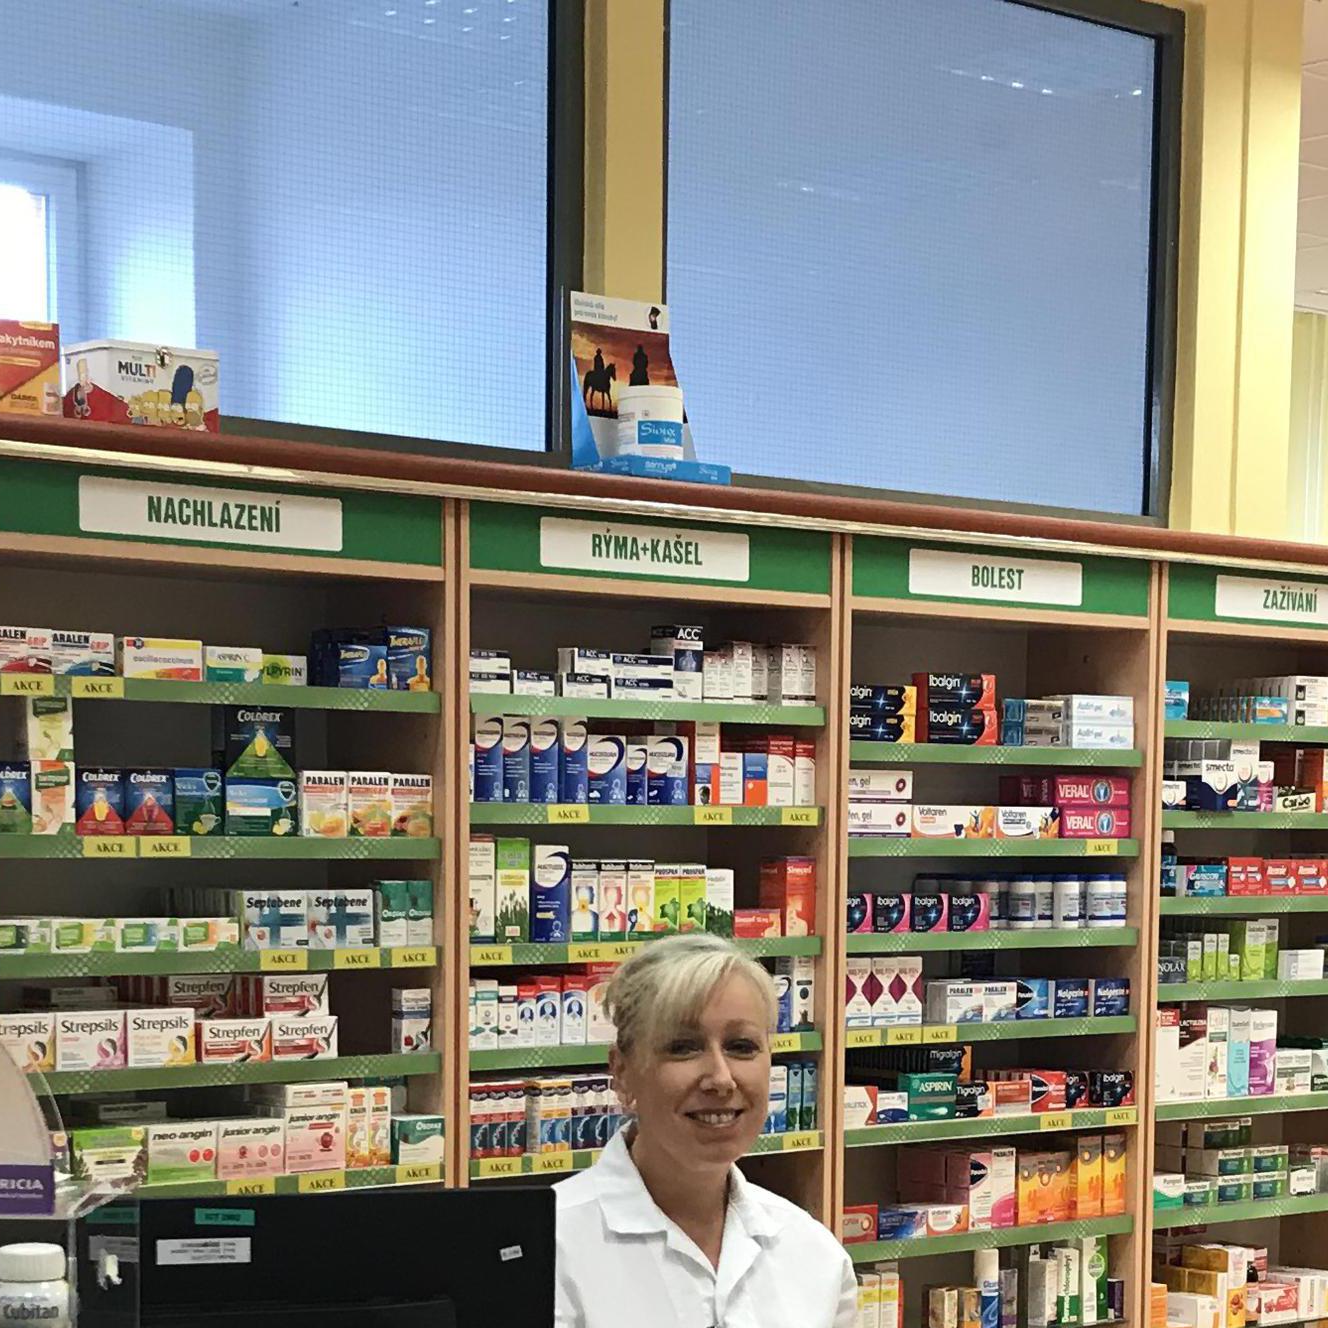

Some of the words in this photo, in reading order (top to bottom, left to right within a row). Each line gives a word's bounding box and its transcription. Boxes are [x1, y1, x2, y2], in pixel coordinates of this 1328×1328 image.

[118, 361, 155, 377] MULTI
[148, 496, 281, 533] NACHLAZENÍ
[592, 528, 703, 565] RÝMA+KAŠEL
[972, 565, 1024, 590] BOLEST
[1263, 585, 1317, 613] ZAŽÍVÁNÍ
[678, 628, 700, 640] ACC
[13, 680, 43, 692] AKCE
[82, 683, 113, 694] AKCE
[237, 708, 282, 723] COLDREX
[306, 775, 344, 786] PARALEN
[351, 776, 388, 786] PARALEN
[393, 777, 430, 787] PARALEN
[1059, 784, 1088, 797] VERAL
[919, 807, 946, 817] Voltaren
[1066, 815, 1093, 829] VERAL
[96, 842, 123, 853] AKCE
[151, 841, 179, 852] AKCE
[271, 953, 297, 964] AKCE
[345, 953, 371, 964] AKCE
[402, 952, 427, 962] AKCE
[174, 980, 225, 994] Strepfen
[269, 980, 319, 994] Strepfen
[61, 1018, 119, 1035] Strepsils
[133, 1017, 189, 1032] Strepsils
[278, 1023, 328, 1038] Strepfen
[209, 1025, 260, 1039] Strepfen
[918, 1080, 953, 1092] ASPIRIN
